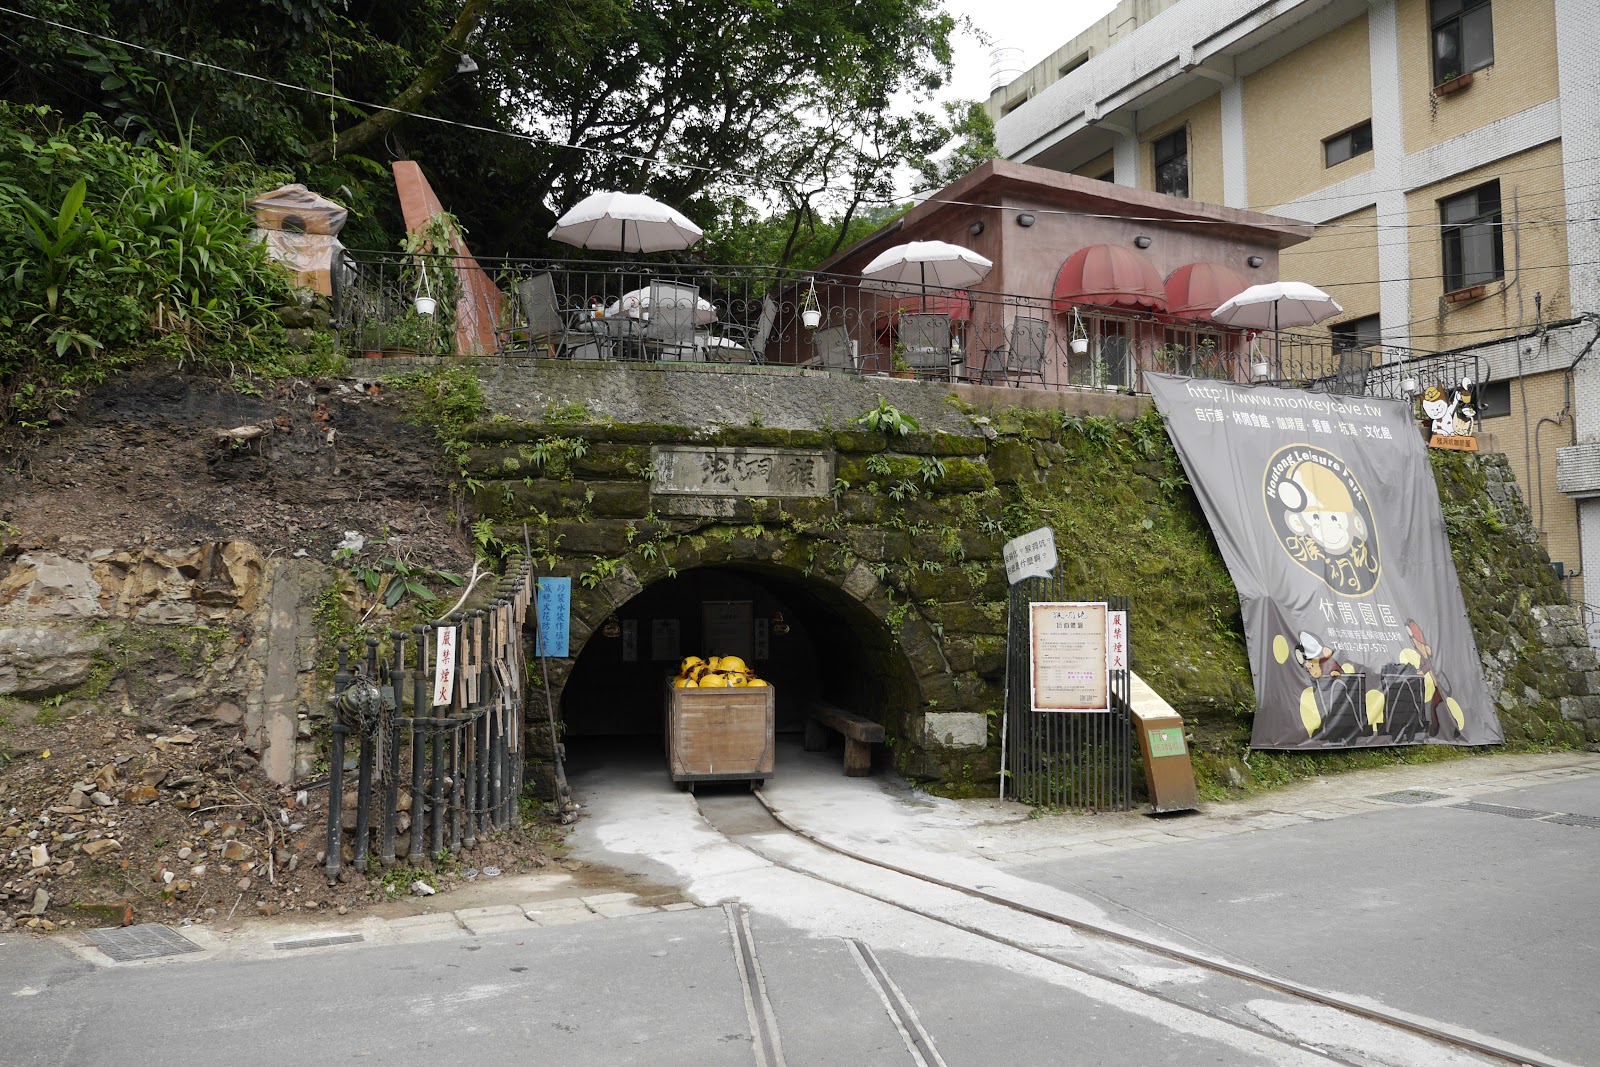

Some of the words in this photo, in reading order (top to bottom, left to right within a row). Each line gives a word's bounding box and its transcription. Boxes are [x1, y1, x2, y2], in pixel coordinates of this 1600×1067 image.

[1186, 383, 1382, 417] http://www.monkeycave.tw
[1266, 453, 1296, 499] Houtong
[1294, 450, 1340, 471] Leisure
[1319, 598, 1399, 627] 休閒園區
[1112, 614, 1123, 667] 嚴禁煙火
[438, 630, 451, 701] 嚴禁煙火
